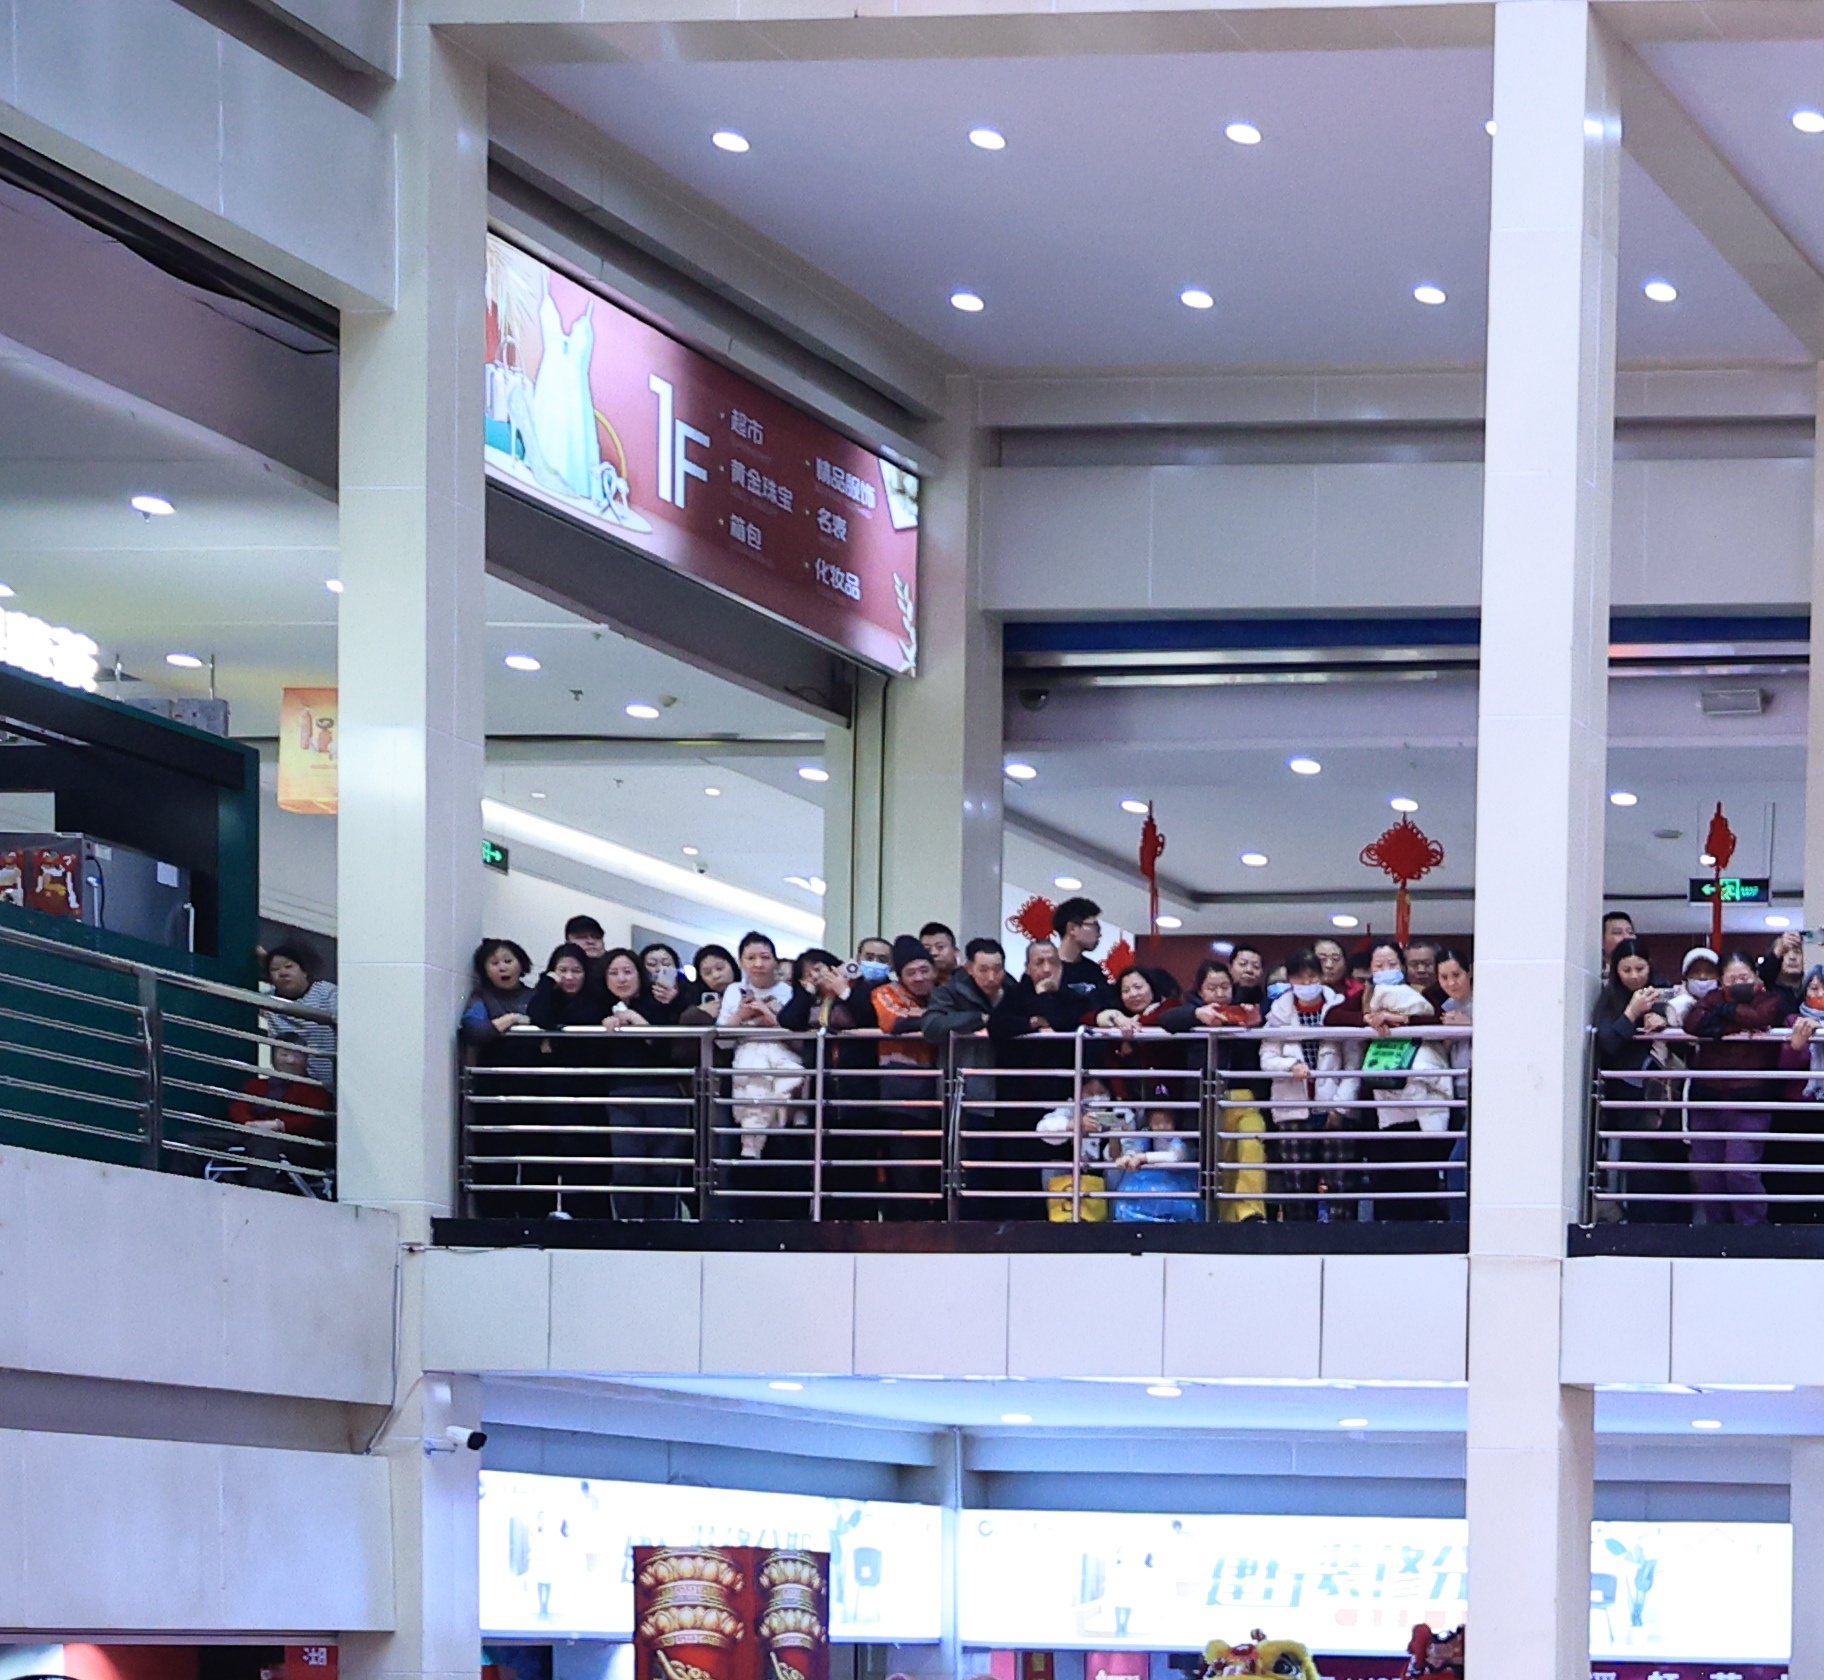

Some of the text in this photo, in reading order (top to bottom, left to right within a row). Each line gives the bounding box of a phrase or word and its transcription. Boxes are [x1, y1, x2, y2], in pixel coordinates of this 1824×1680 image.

[649, 373, 710, 508] 1F
[730, 408, 763, 445] 超市
[731, 459, 793, 514] 黄金珠宝
[730, 512, 762, 550] 箱包
[817, 507, 847, 542] 名表
[815, 557, 861, 601] 化妆品
